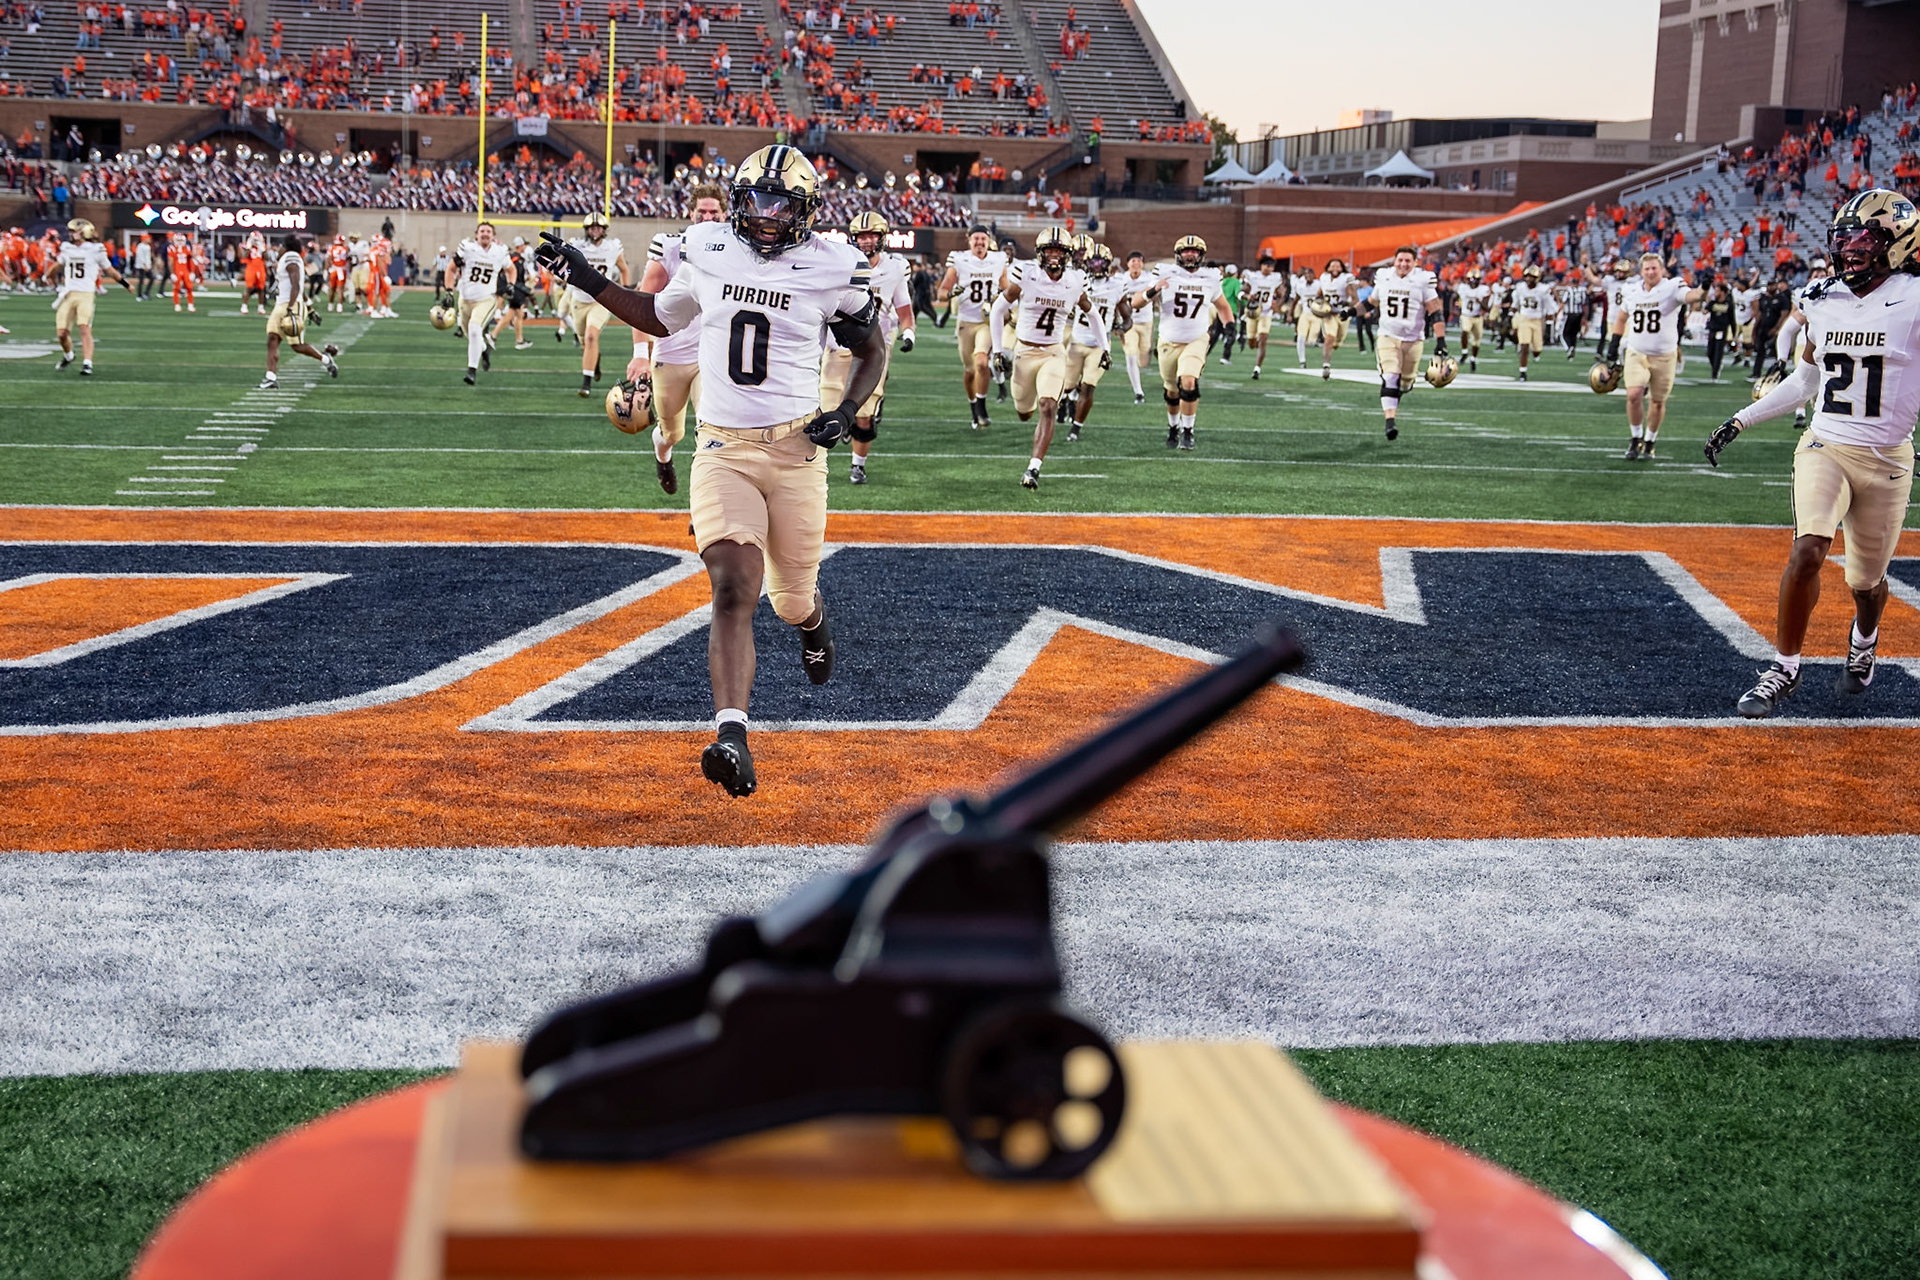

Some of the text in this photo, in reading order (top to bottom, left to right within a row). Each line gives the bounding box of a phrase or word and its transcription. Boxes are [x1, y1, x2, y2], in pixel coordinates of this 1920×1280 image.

[236, 208, 307, 229] Gemini
[70, 262, 85, 279] 15
[469, 267, 494, 284] 85
[721, 284, 792, 311] PURDUE
[970, 279, 993, 303] 81
[1035, 296, 1066, 308] PURDUE
[1173, 292, 1205, 319] 57
[1387, 296, 1410, 319] 51
[1035, 307, 1058, 336] 4
[1633, 309, 1662, 334] 98
[728, 309, 772, 387] 0
[1825, 331, 1886, 347] PURDUE
[1821, 352, 1886, 418] 21
